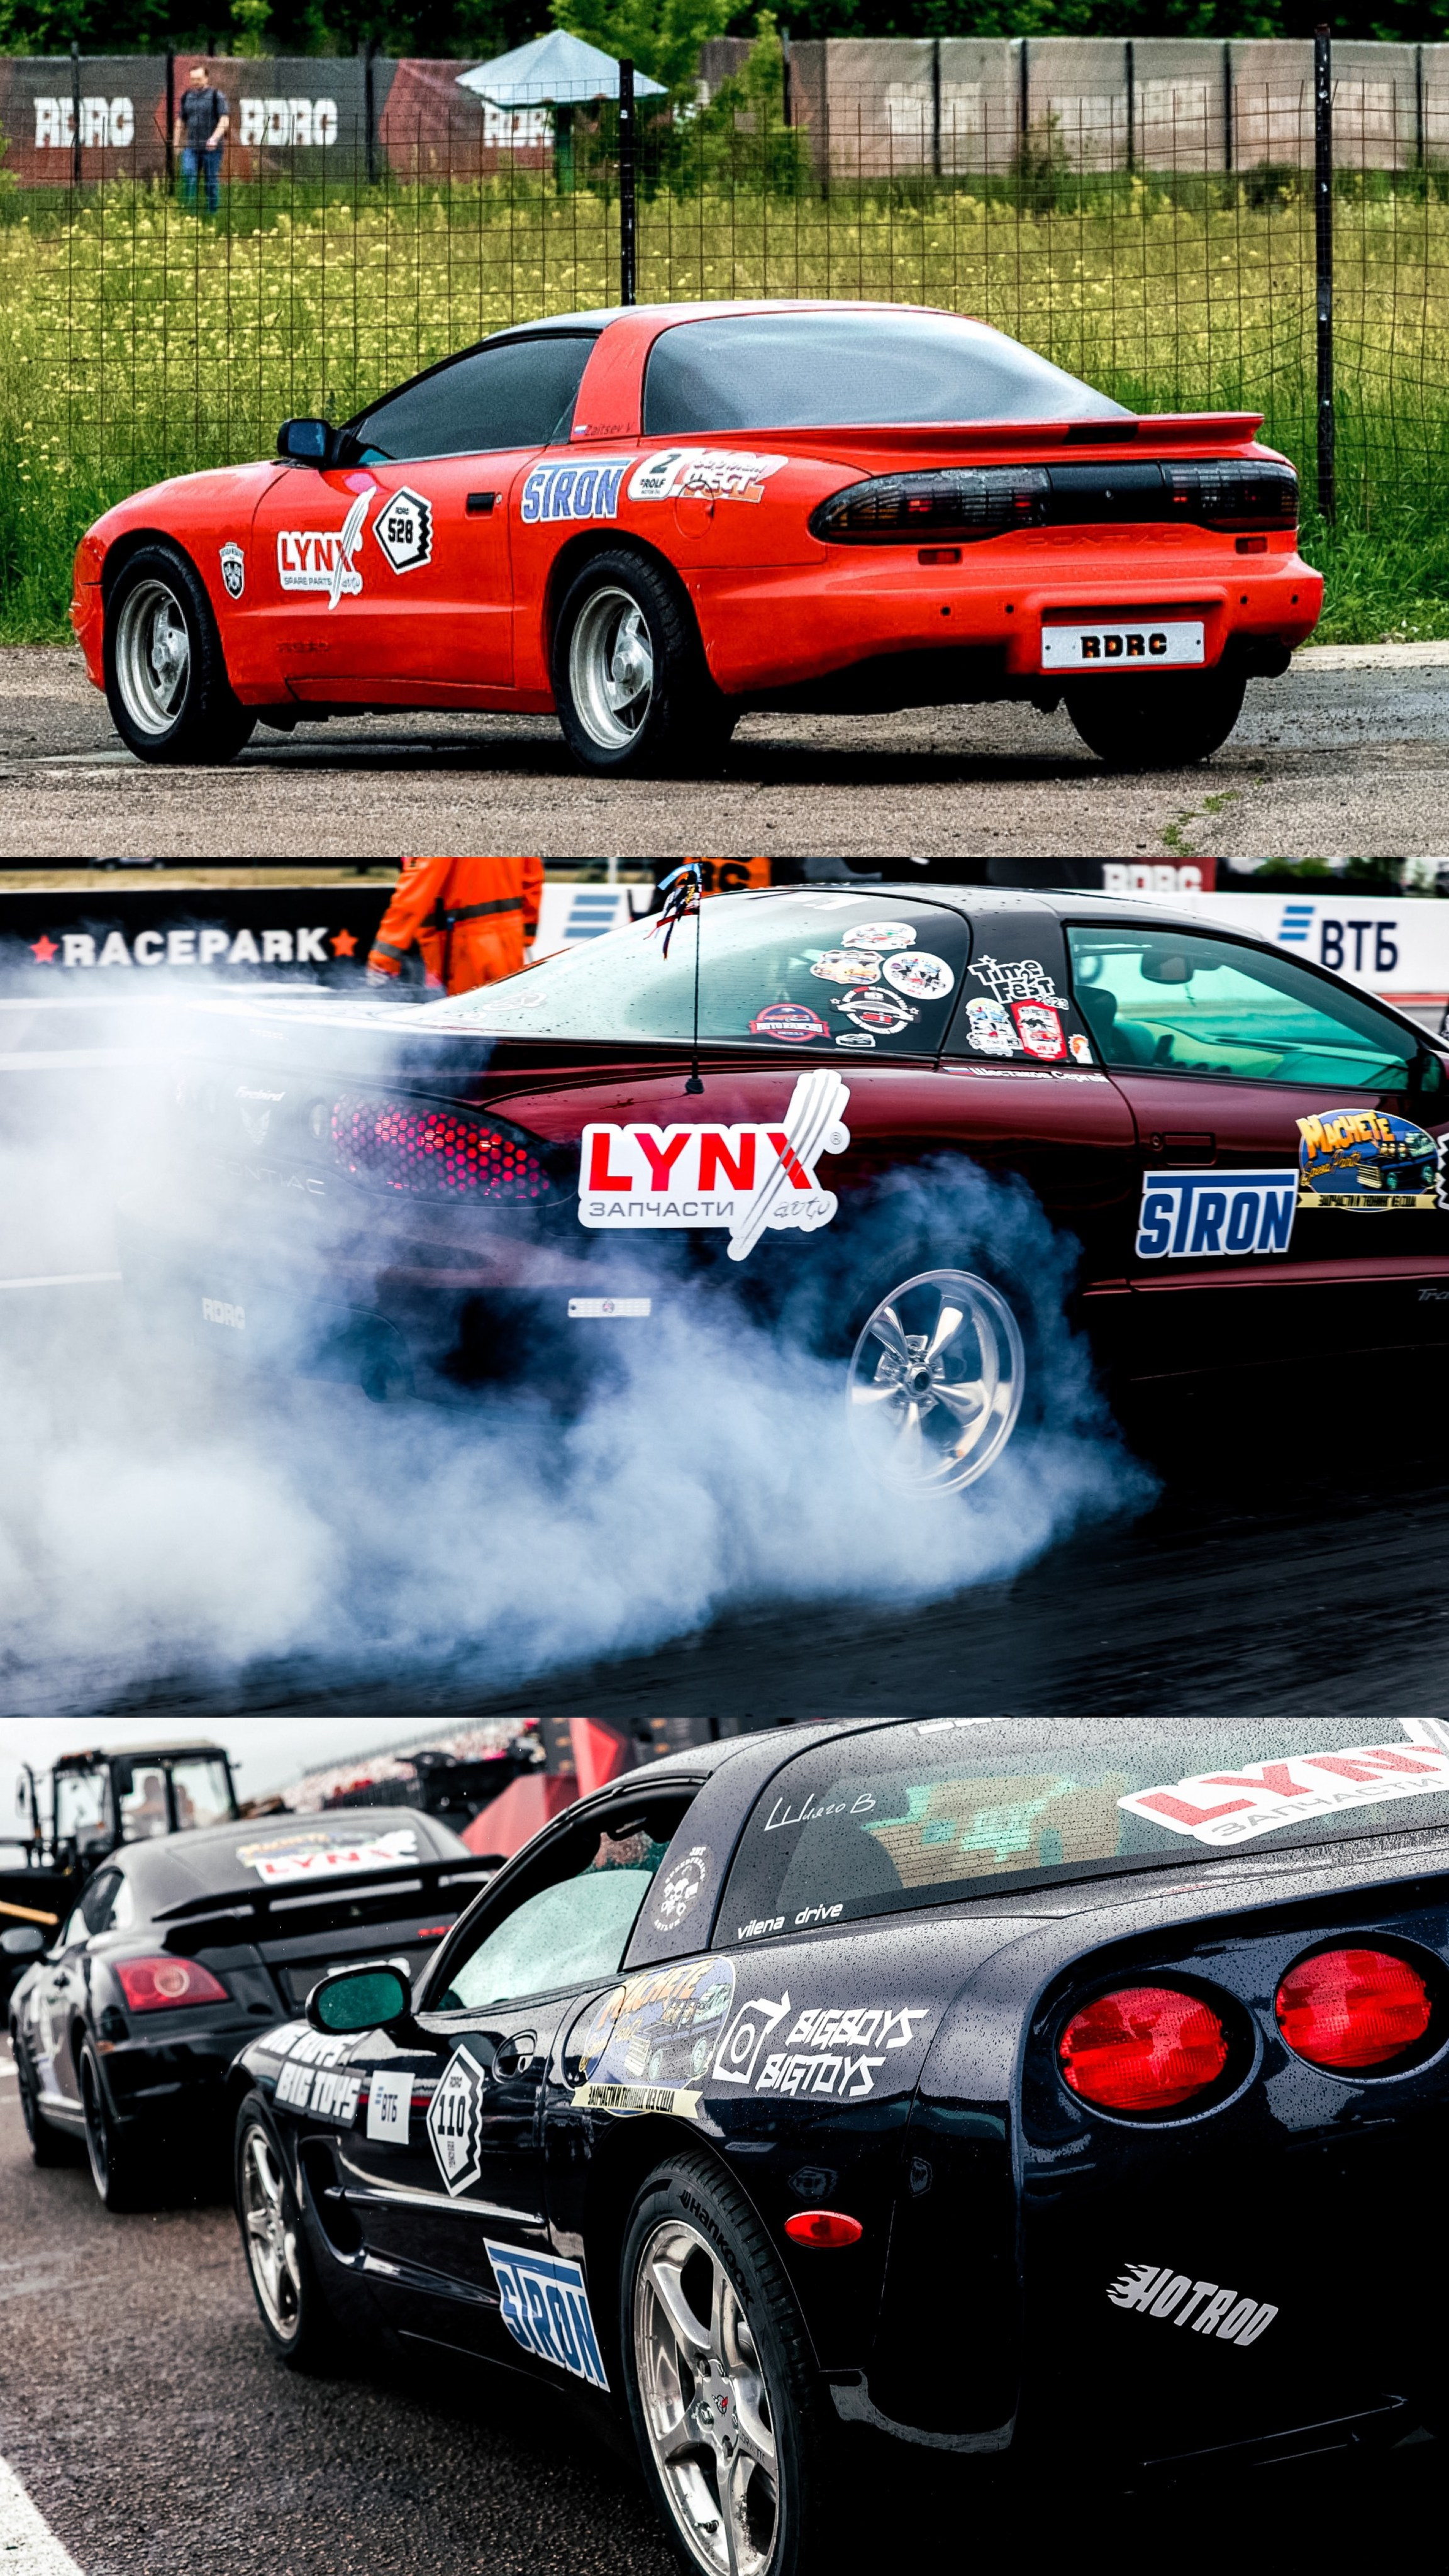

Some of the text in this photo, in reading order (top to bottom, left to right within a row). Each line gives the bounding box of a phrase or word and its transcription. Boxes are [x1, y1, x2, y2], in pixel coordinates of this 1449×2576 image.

[649, 453, 682, 474] 2
[523, 460, 632, 519] STRON
[387, 518, 413, 544] 528
[282, 538, 354, 573] LYNX
[284, 577, 332, 586] SPARE PARTS
[1080, 633, 1167, 658] RDRC
[61, 928, 330, 967] RACEPARK
[1320, 919, 1399, 972] ВТБ
[969, 1067, 1109, 1083] Шестаков Сергей
[1296, 1111, 1395, 1159] MACHETE
[589, 1132, 813, 1191] LYNX
[588, 1201, 735, 1218] ЗАПЧАСТИ
[1138, 1174, 1296, 1255] STRON
[1211, 1775, 1446, 1838] ЗАПЧАСТИ
[737, 1901, 843, 1940] vilena drive
[786, 2008, 930, 2050] BIGBOYS
[275, 2062, 362, 2120] BIG TOYS
[755, 2053, 886, 2097] BIGTOYS
[438, 2094, 466, 2137] 110
[487, 2246, 606, 2385] STRON
[1106, 2263, 1279, 2346] HOTROD
